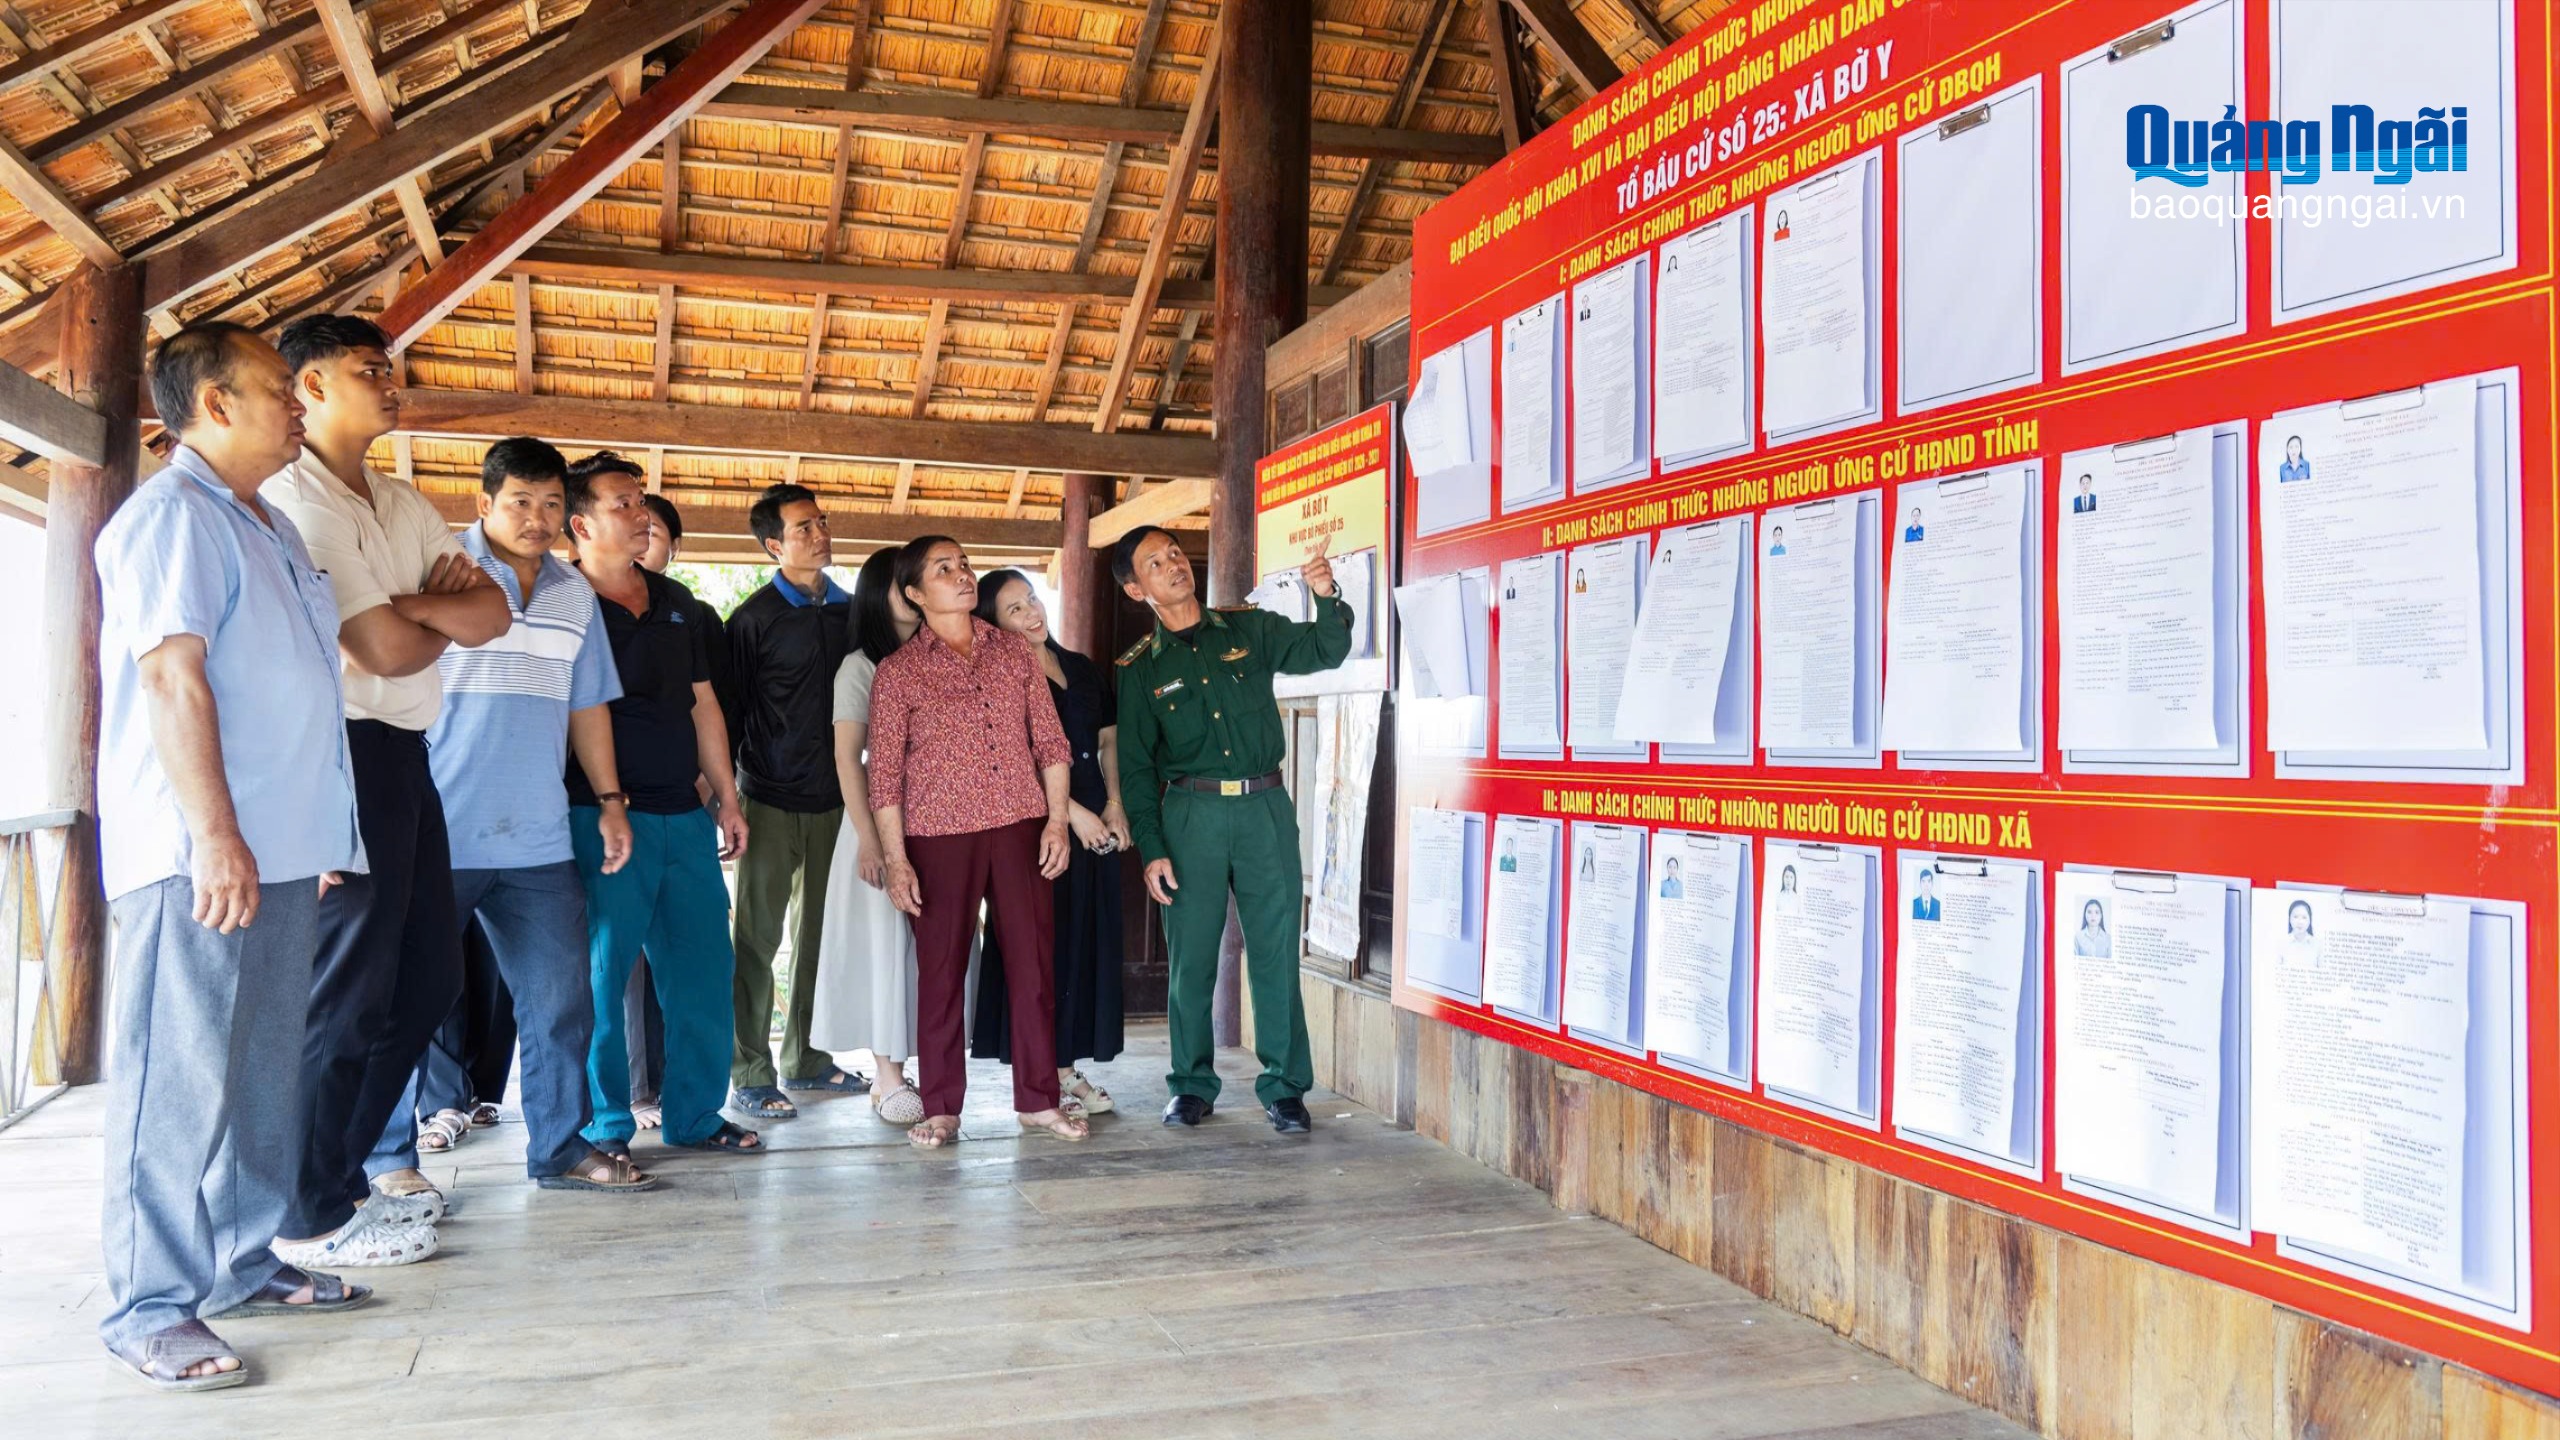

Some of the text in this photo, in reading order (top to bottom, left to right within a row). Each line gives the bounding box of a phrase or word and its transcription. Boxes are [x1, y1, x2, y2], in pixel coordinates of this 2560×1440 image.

[1450, 235, 1466, 265] ĐẠI
[1468, 214, 1491, 254] BIỂU
[1493, 197, 1521, 240] QUỐC
[1524, 186, 1542, 221] HỘI
[1545, 167, 1577, 208] KHÓA
[1580, 152, 1602, 187] XVI
[1604, 136, 1622, 172] VÀ
[1626, 122, 1650, 160] ĐẠI
[1654, 94, 1689, 144] BIỂU
[1693, 80, 1721, 121] HỘI
[1725, 50, 1774, 104] ĐỒNG
[1779, 14, 1835, 73] NHÂN
[1572, 105, 1608, 150] DANH
[1611, 78, 1649, 125] SÁCH
[1652, 46, 1699, 99] CHÍNH
[1703, 17, 1747, 67] THỨC
[1617, 39, 1894, 214] TỔ BẦU CỬ SỐ 25: XÃ BỜ Y
[1559, 51, 2001, 285] I: DANH SÁCH CHÍNH THỨC NHỮNG NGƯỜI ỨNG CỬ ĐBQH
[1338, 517, 1344, 530] 25
[1542, 417, 2039, 548] II: DANH SÁCH CHÍNH THỨC NHỮNG NGƯỜI ỨNG CỬ HĐND TỈNH
[1543, 788, 2033, 850] III: DANH SÁCH CHÍNH THỨC NHỮNG NGƯỜI ỨNG CỬ HĐND XÃ
